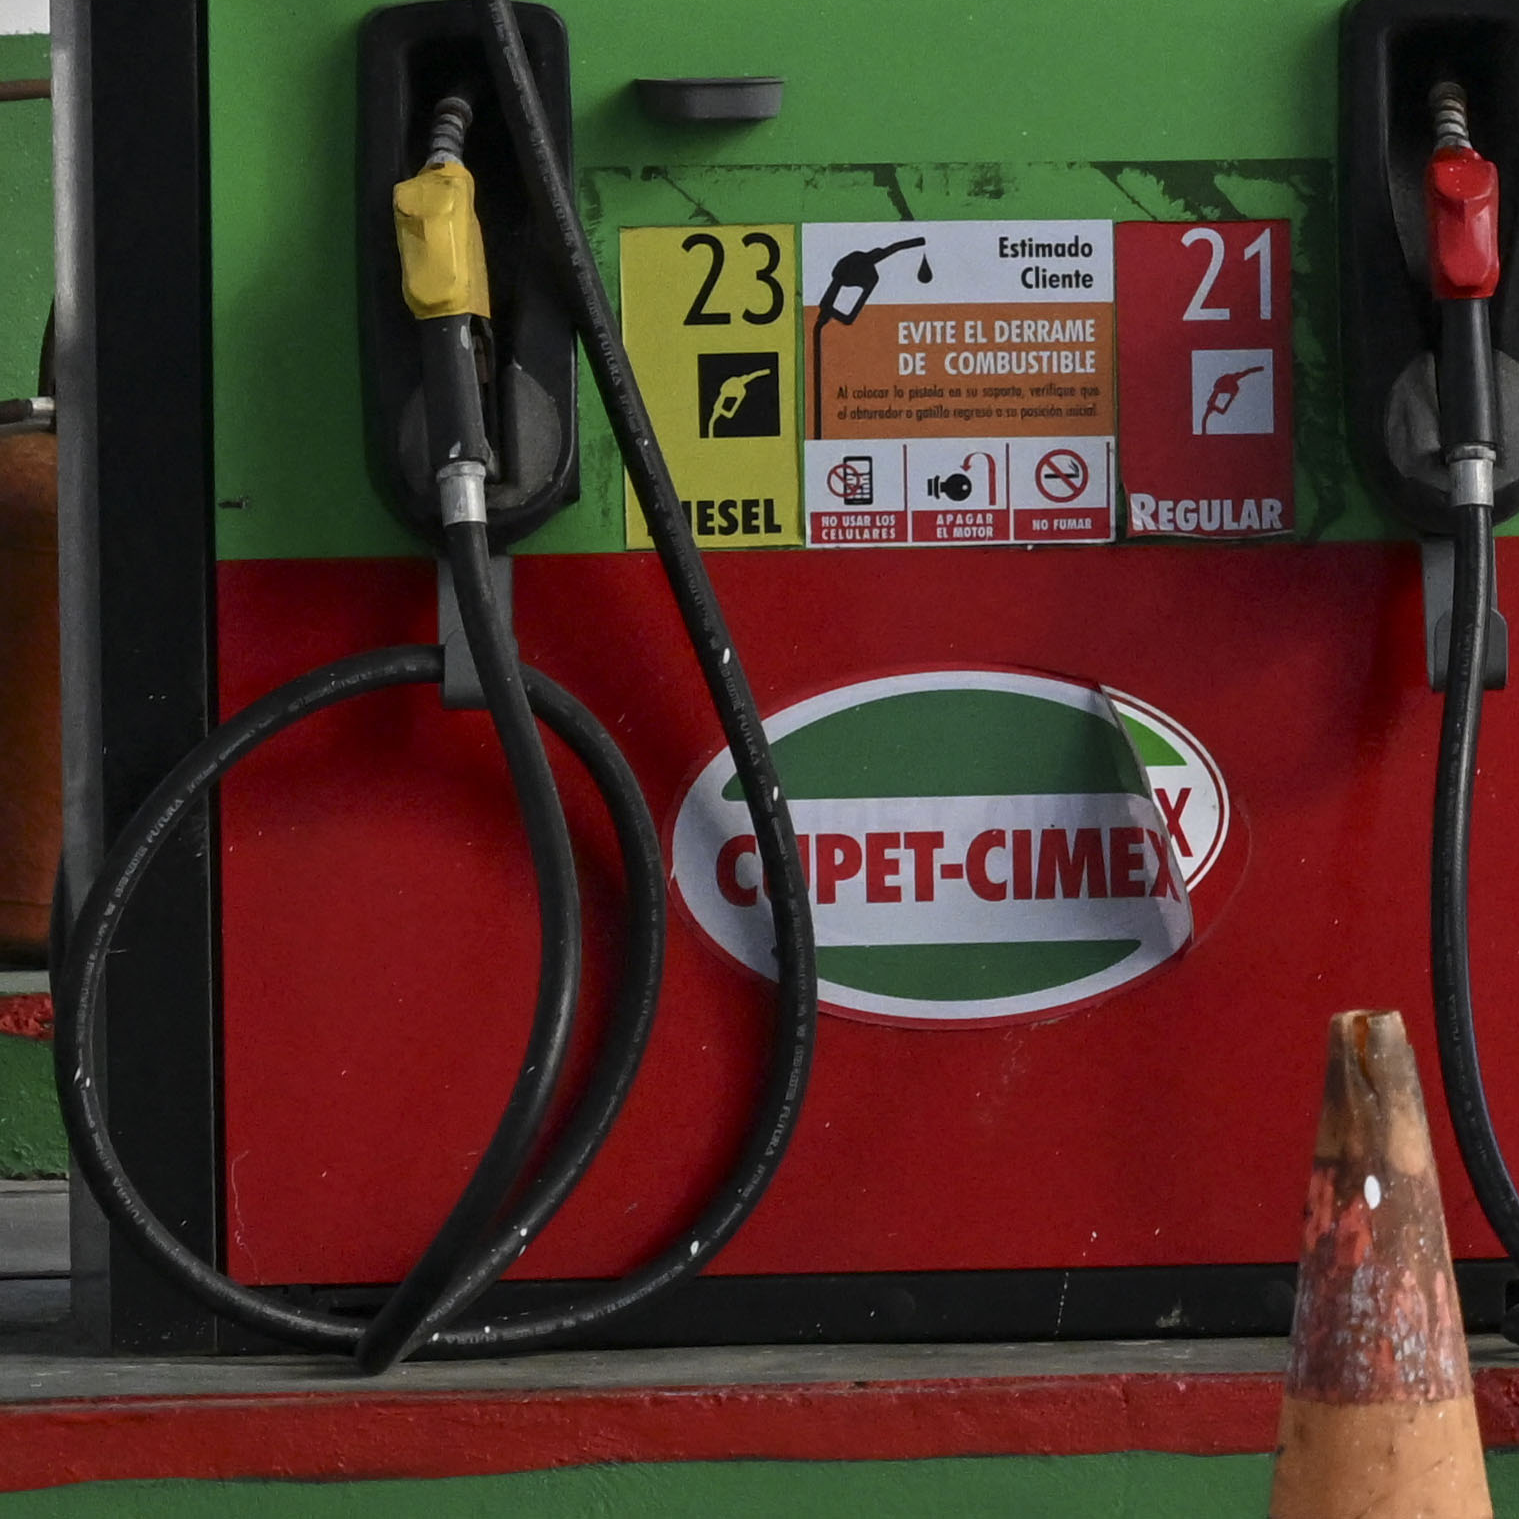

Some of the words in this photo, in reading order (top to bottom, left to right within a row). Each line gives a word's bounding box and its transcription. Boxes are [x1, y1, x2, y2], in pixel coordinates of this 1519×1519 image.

[998, 235, 1093, 259] Estimado
[681, 232, 785, 327] 23
[1020, 266, 1094, 289] Cliente
[1182, 227, 1272, 321] 21
[898, 321, 956, 344] EVITE
[964, 321, 988, 343] EL
[994, 319, 1096, 343] DERRAME
[898, 353, 926, 375] DE
[944, 350, 1096, 375] COMBUSTIBLE
[837, 386, 848, 399] Al
[853, 386, 888, 399] colocar
[838, 406, 846, 419] el
[851, 404, 902, 419] obturador
[822, 516, 837, 527] NO
[842, 515, 871, 526] USAR
[876, 515, 896, 526] LOS
[936, 513, 993, 525] APAGAR
[1130, 492, 1283, 531] REGULAR
[822, 527, 896, 539] CELULARES
[937, 527, 950, 538] EL
[953, 527, 993, 538] MOTOR
[1032, 519, 1049, 530] NO
[1054, 518, 1092, 529] FUMAR
